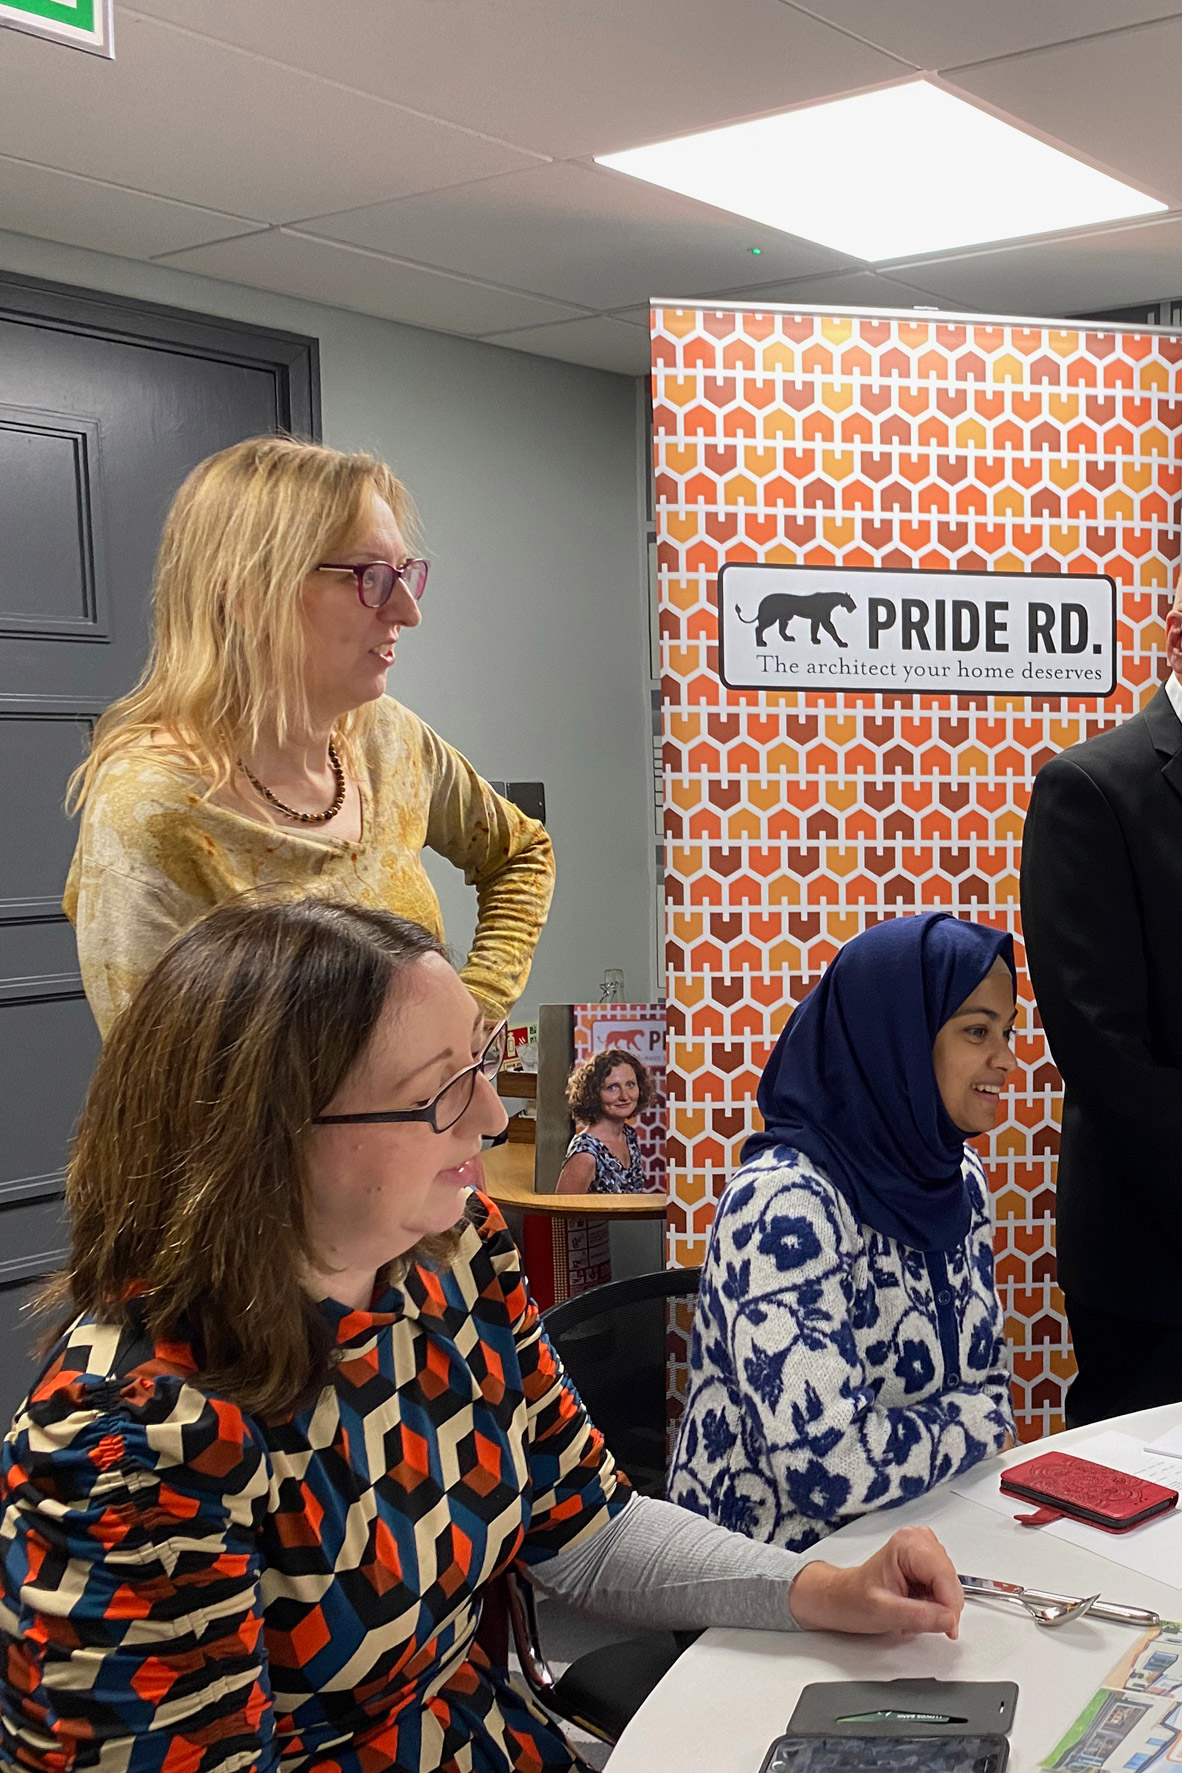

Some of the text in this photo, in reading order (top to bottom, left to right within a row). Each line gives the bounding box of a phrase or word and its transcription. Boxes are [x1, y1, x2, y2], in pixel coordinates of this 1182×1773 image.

[868, 597, 1103, 655] PRIDE RD.
[756, 655, 1102, 682] The architect your home deserves
